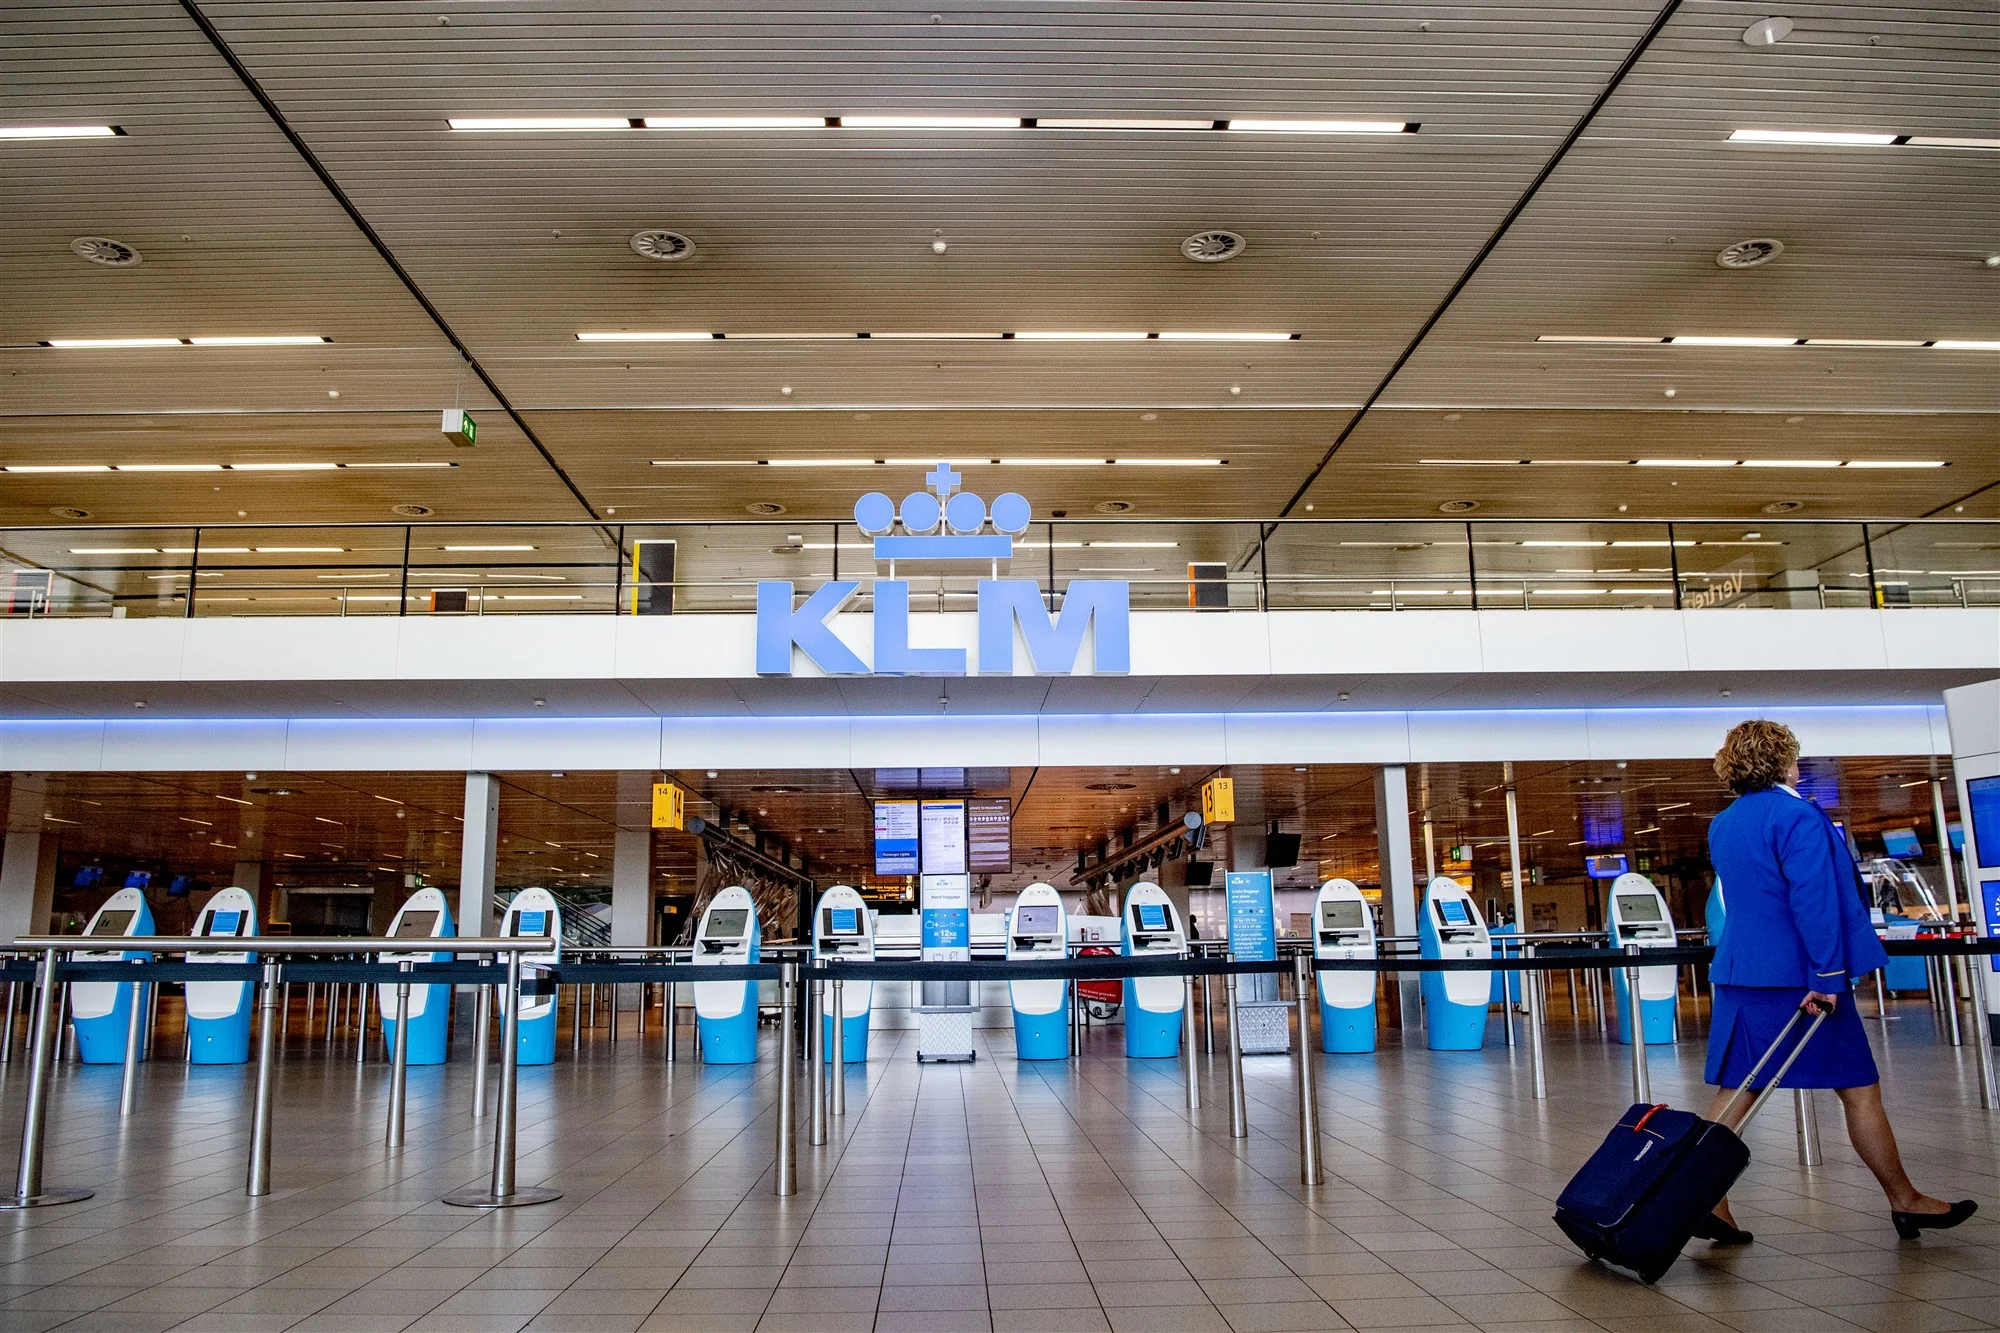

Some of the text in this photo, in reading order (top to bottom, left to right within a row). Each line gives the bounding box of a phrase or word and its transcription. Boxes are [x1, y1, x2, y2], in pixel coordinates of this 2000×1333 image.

[757, 580, 1130, 676] KLM
[658, 788, 668, 796] 14
[1204, 784, 1212, 813] 13
